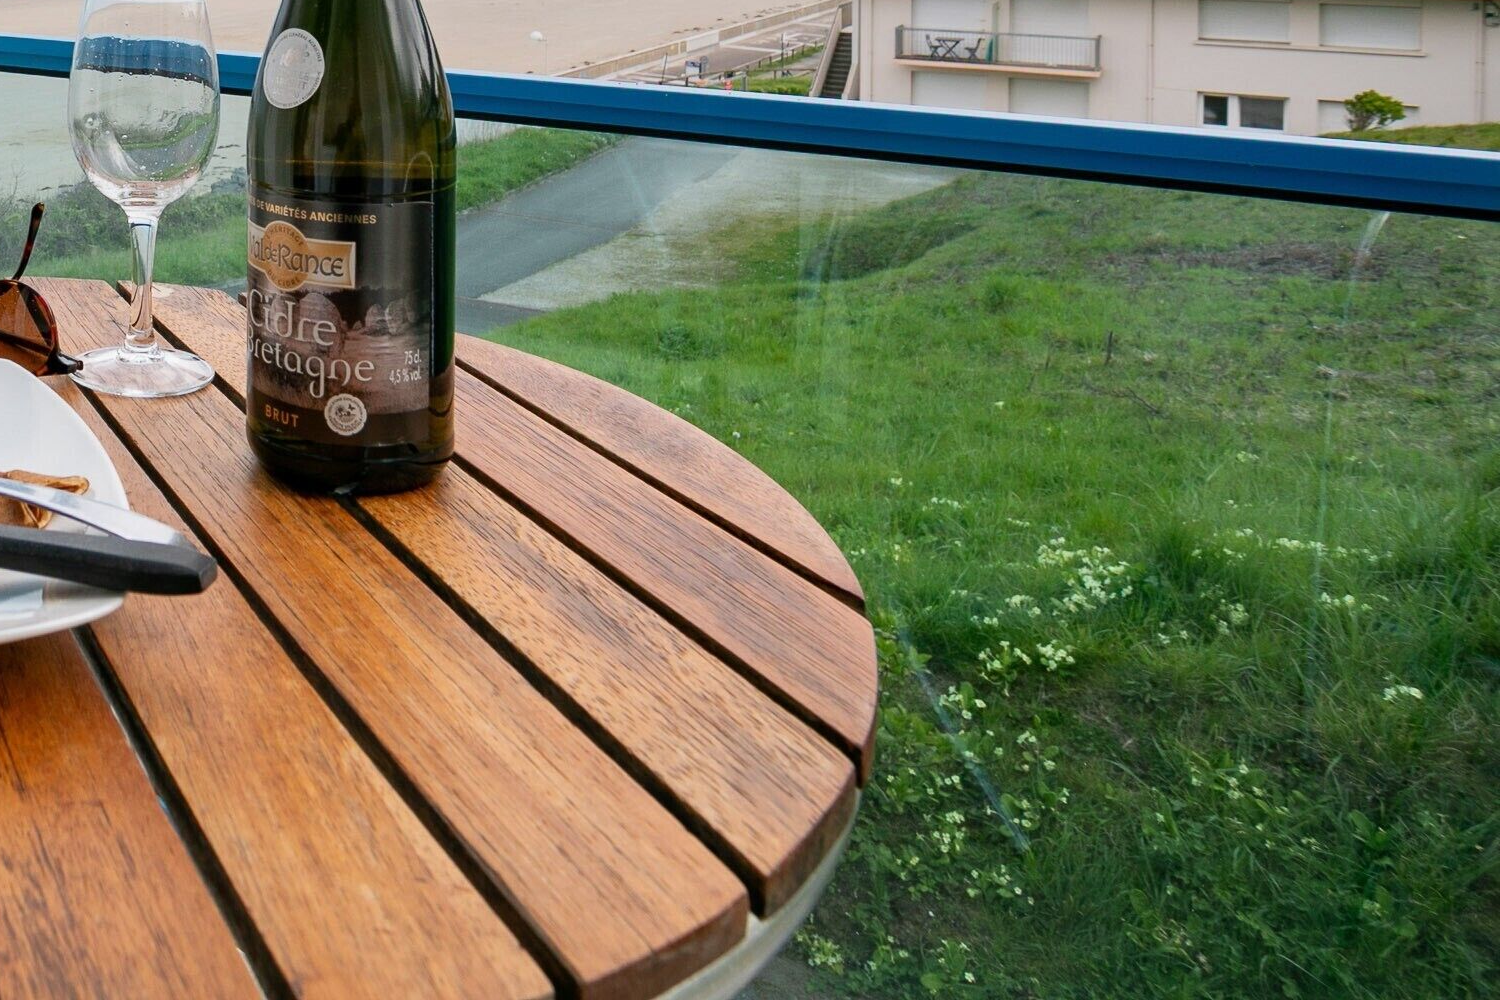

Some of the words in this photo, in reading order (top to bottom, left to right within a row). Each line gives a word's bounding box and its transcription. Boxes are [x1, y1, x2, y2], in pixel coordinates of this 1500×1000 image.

[265, 202, 307, 220] VARIÉTÉS
[309, 211, 377, 225] ANCIENNES
[249, 288, 337, 346] Cidre
[404, 350, 414, 365] 75
[264, 404, 299, 428] BRUT
